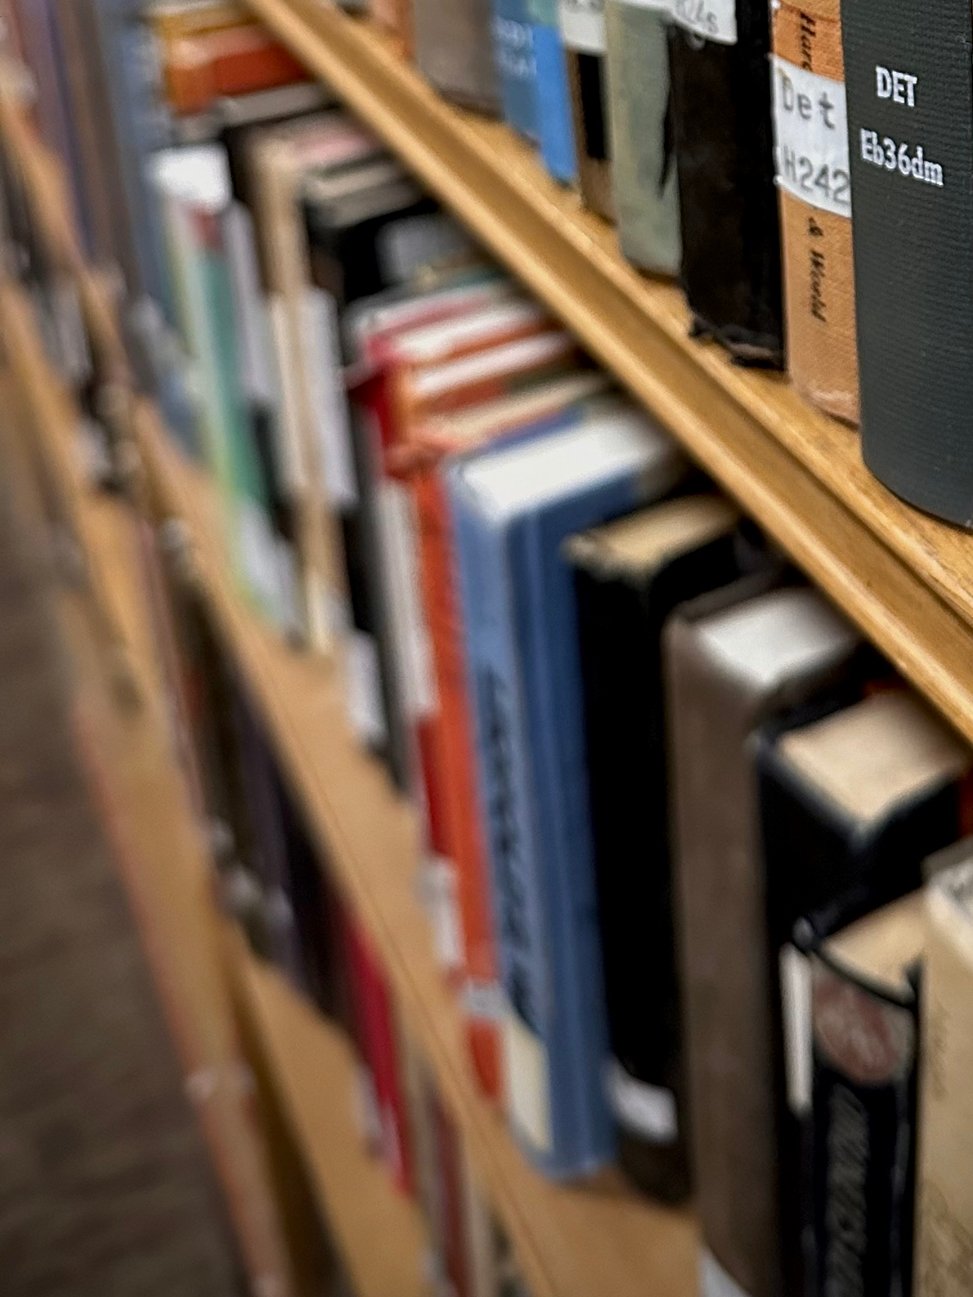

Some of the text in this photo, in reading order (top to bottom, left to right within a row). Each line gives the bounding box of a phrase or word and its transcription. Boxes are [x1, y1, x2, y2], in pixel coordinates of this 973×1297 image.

[778, 67, 836, 131] Det
[875, 64, 918, 107] DET
[859, 128, 945, 187] Eb36dm
